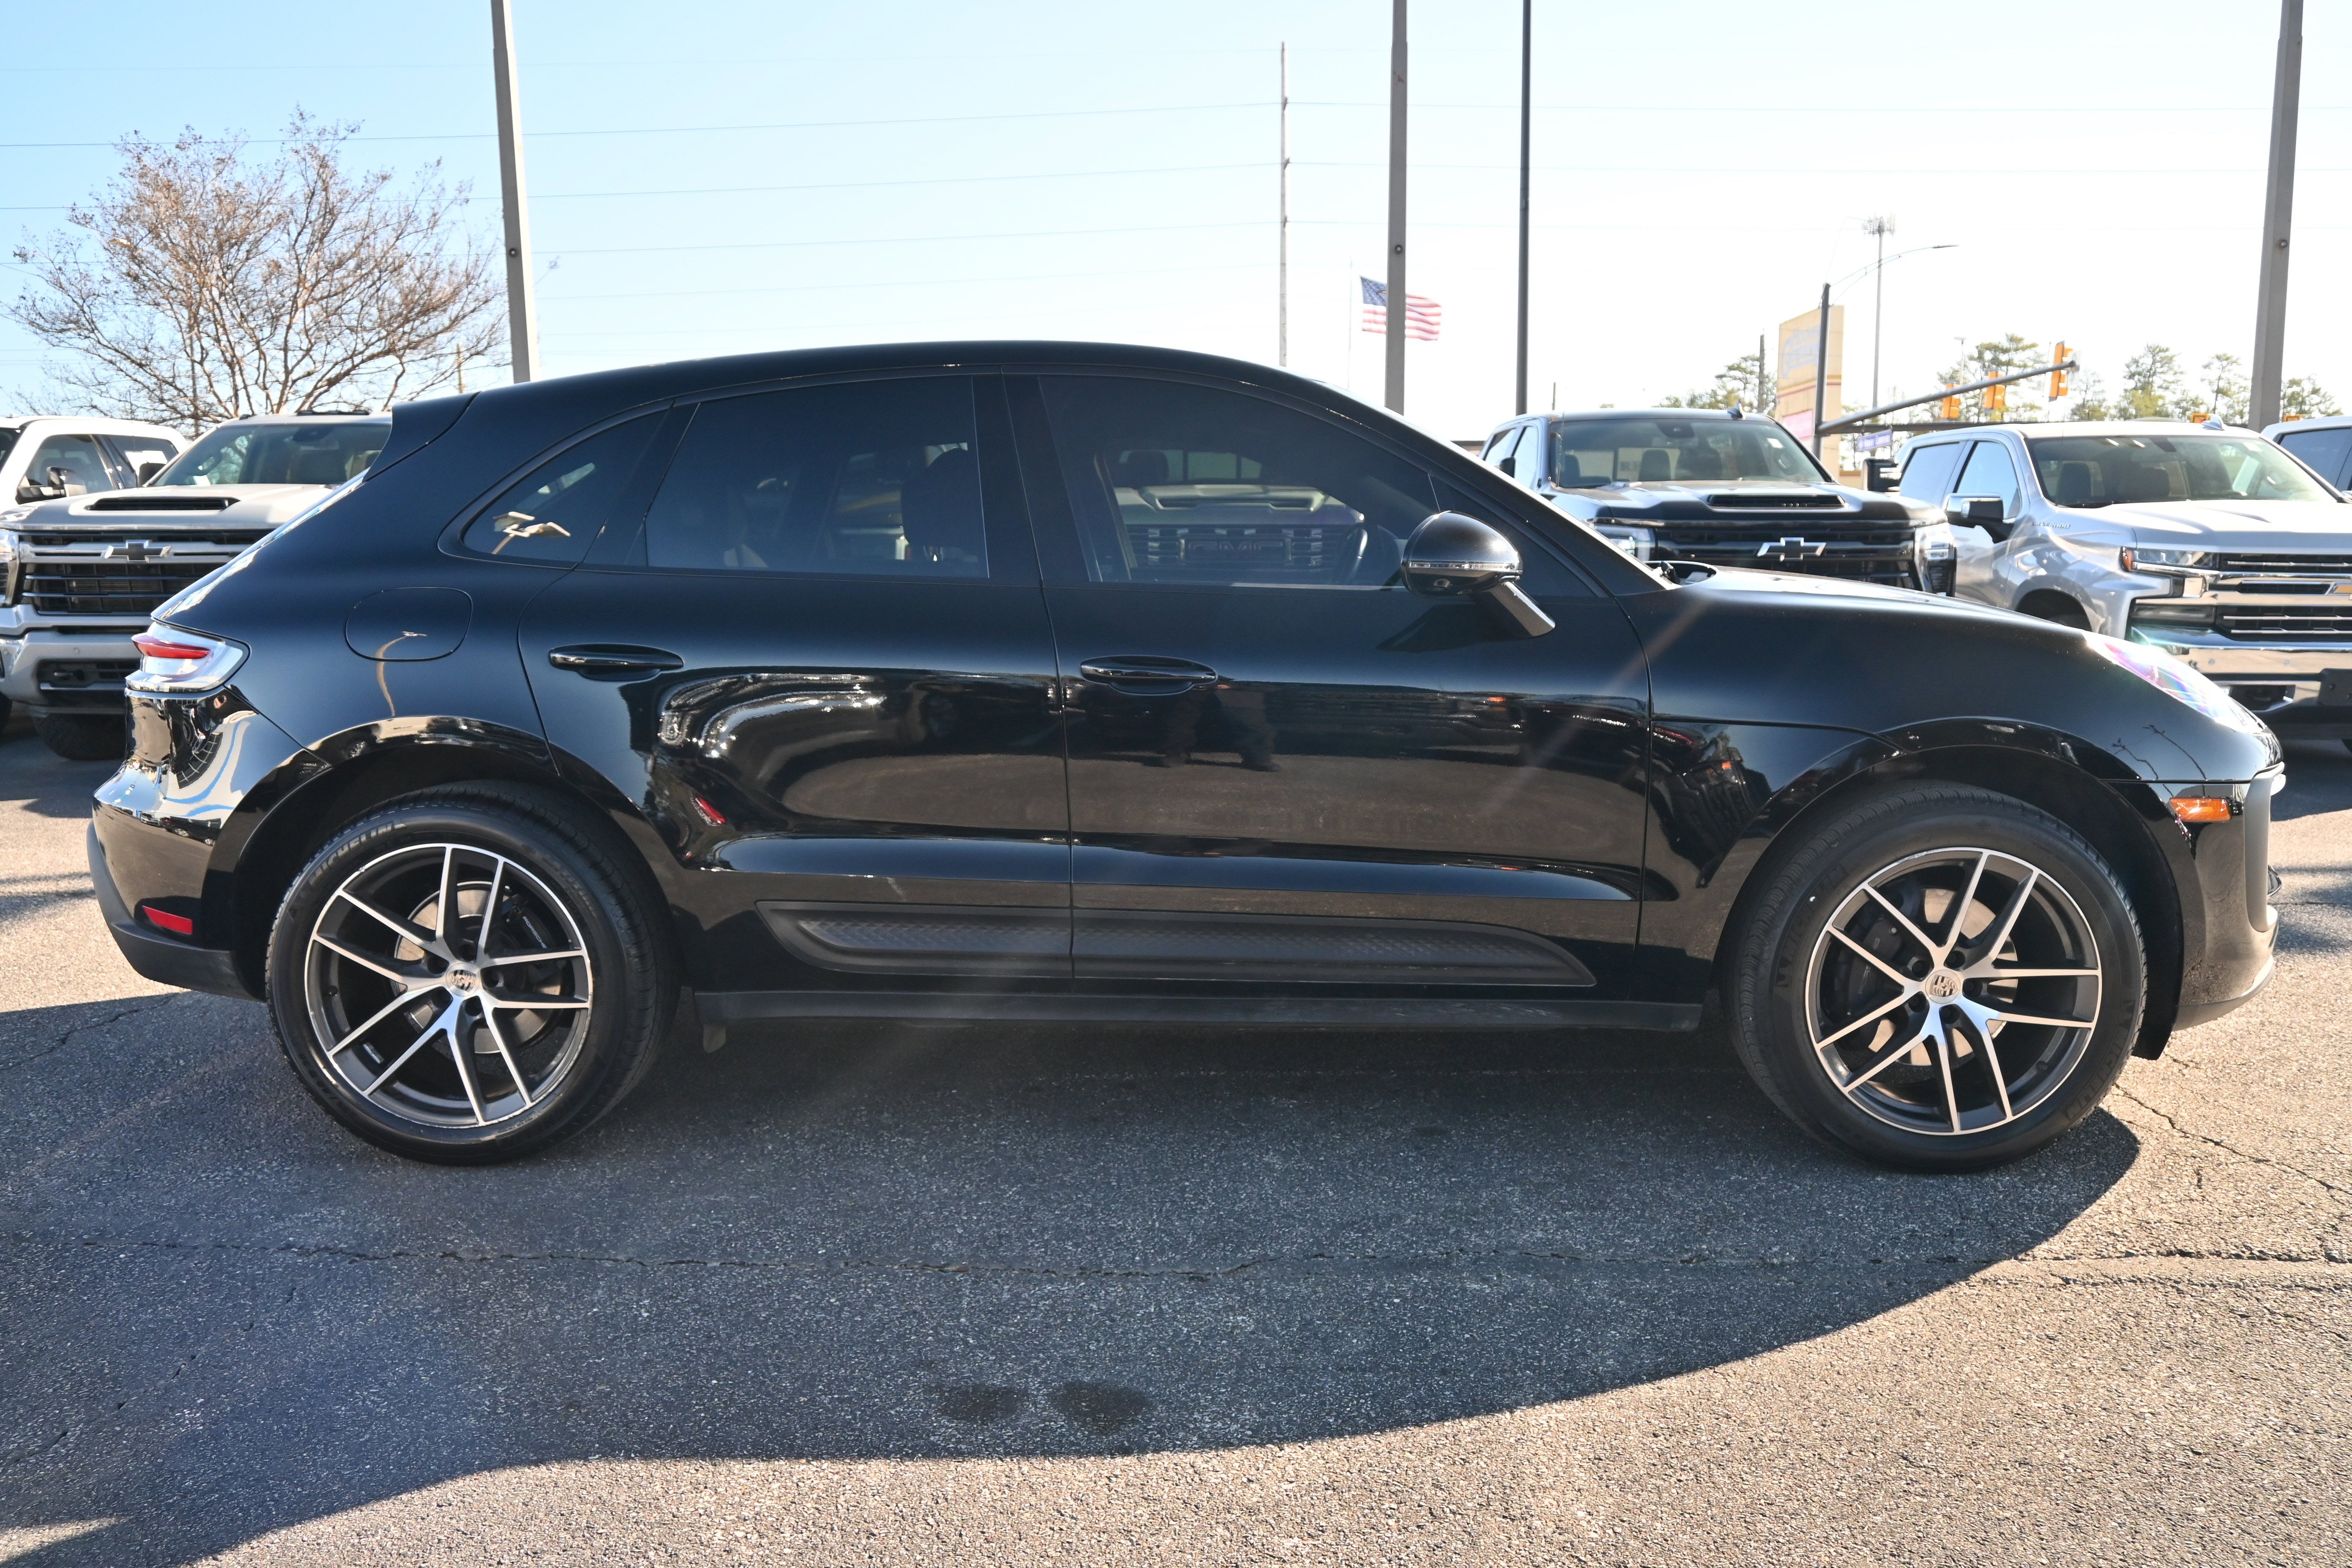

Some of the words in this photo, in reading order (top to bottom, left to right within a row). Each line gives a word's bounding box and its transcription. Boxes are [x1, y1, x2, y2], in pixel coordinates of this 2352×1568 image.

[309, 823, 393, 885] MICHELIN
[522, 915, 547, 949] PORSCHE
[2063, 1025, 2128, 1120] MICHELIN
